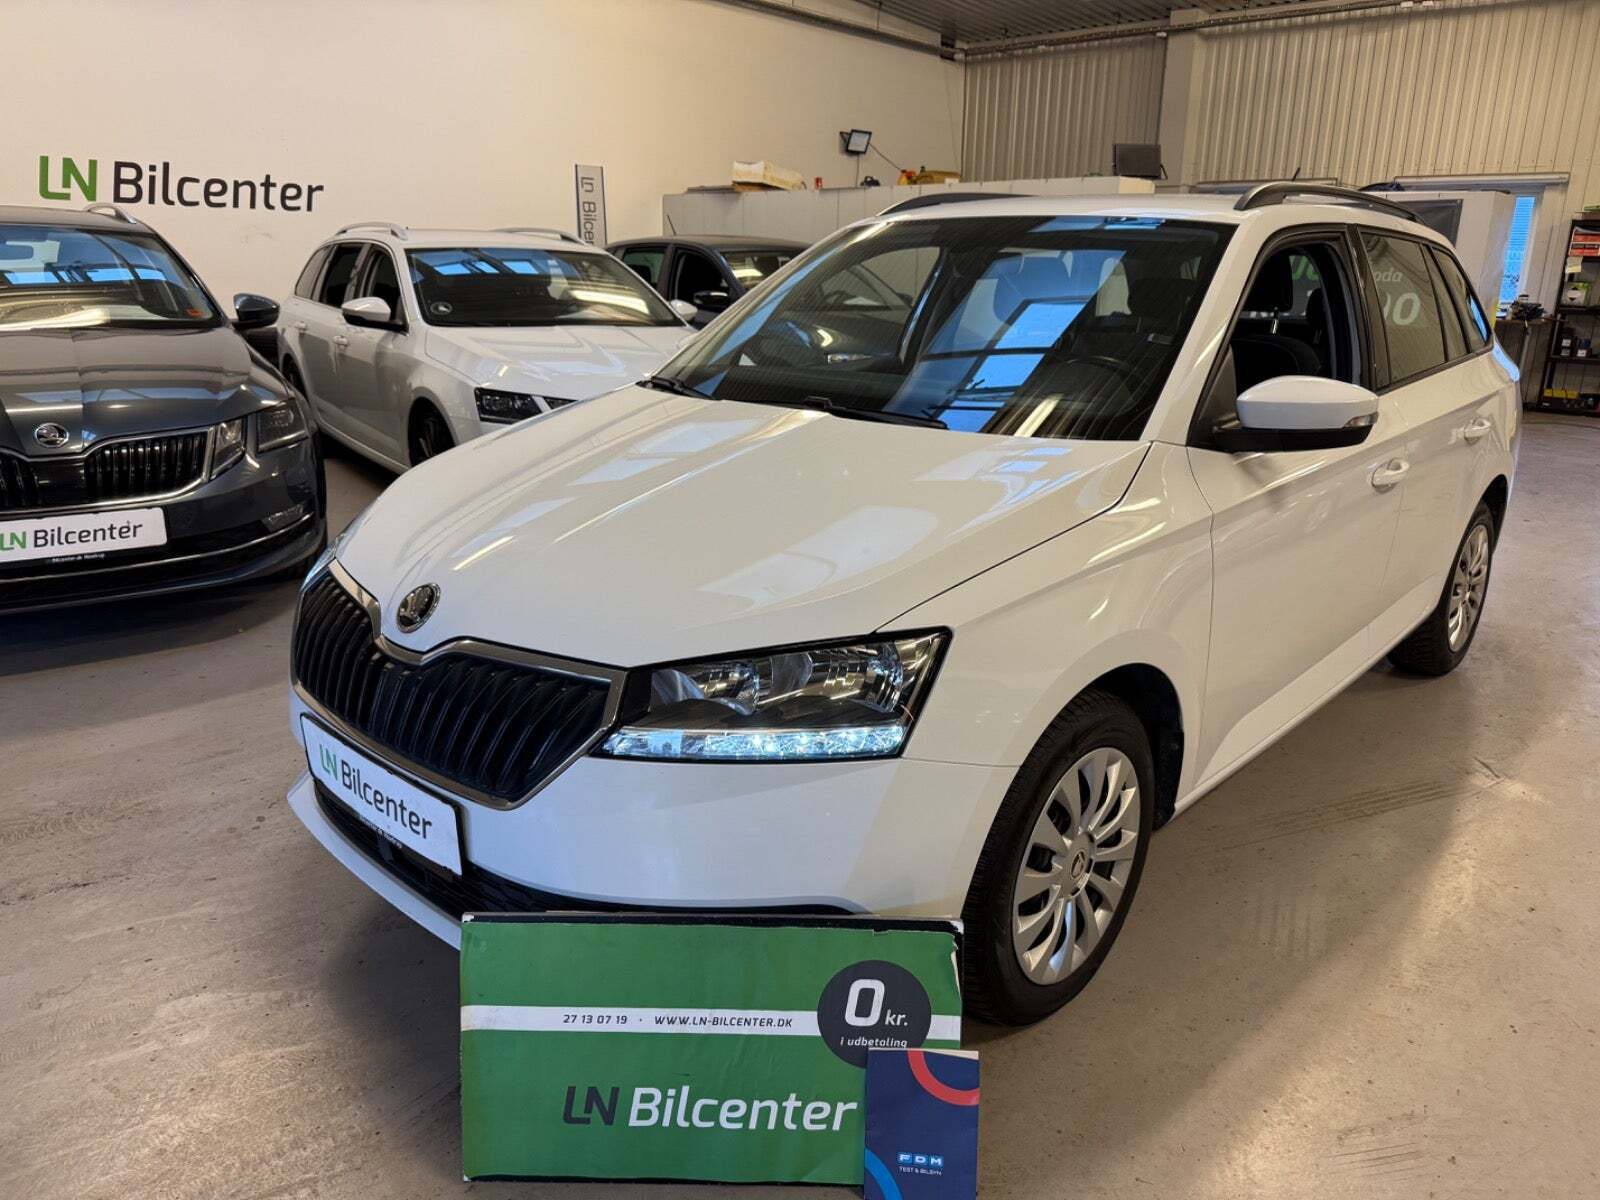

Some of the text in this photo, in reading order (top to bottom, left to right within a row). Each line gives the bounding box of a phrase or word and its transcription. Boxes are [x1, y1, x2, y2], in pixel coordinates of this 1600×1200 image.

[39, 155, 325, 212] LN Bilcenter
[0, 522, 143, 551] LN Bilcenter
[319, 743, 338, 781] LN
[341, 759, 433, 840] Bilcenter
[563, 1014, 793, 1028] 27 13 07 19 WWW.LN-BILCENTER.DK
[884, 1009, 909, 1027] kr.
[847, 1036, 908, 1049] udbetaling
[562, 1085, 858, 1132] LN Bilcenter
[898, 1152, 943, 1167] FDM
